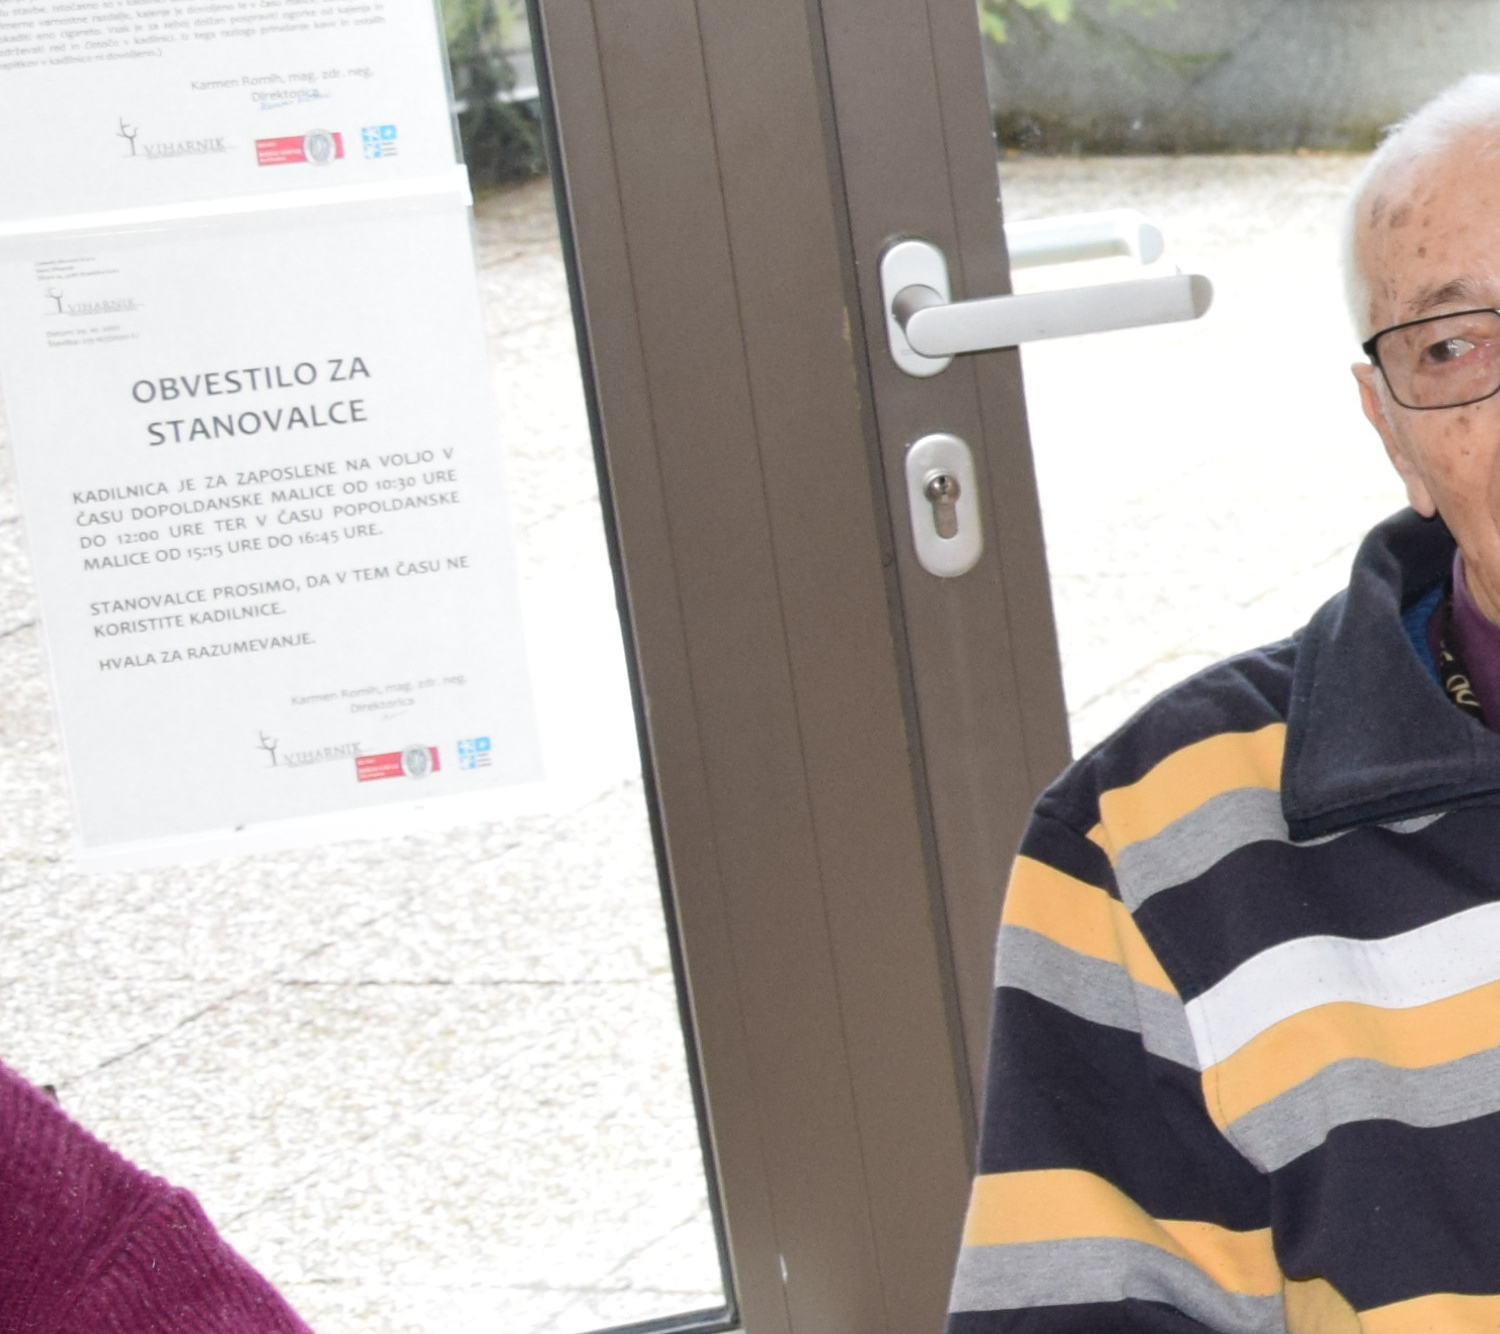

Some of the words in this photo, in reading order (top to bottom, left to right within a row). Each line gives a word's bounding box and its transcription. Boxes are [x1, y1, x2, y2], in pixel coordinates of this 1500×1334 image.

[191, 78, 239, 91] Karmen
[242, 73, 285, 87] Romih,
[251, 88, 319, 103] Direktorica
[144, 137, 226, 157] VIHARNIK
[131, 361, 318, 404] OBVESTILO
[327, 356, 371, 383] ZA
[146, 398, 368, 447] STANOVALCE
[72, 482, 169, 505] KADILNICA
[179, 478, 195, 494] JE
[205, 474, 228, 489] ZA
[236, 461, 337, 486] ZAPOSLENE
[345, 457, 371, 472] NA
[379, 450, 434, 467] VOLJO
[442, 448, 453, 461] V
[75, 508, 123, 527] ČASU
[130, 492, 262, 521] DOPOLDANSKE
[271, 484, 334, 503] MALICE
[342, 480, 368, 495] OD
[375, 476, 416, 491] 10:30
[423, 469, 456, 485] URE
[79, 534, 107, 550] DO
[117, 530, 159, 544] 12:00
[169, 522, 204, 539] URE
[214, 517, 247, 532] TER
[255, 515, 267, 527] V
[277, 508, 323, 525] ČASU
[333, 491, 459, 517] POPOLDANSKE
[83, 551, 150, 571] MALICE
[155, 548, 182, 563] OD
[227, 537, 262, 554] URE
[267, 534, 293, 549] DO
[298, 529, 339, 545] 16:45
[343, 523, 383, 540] URE.
[90, 589, 206, 616] STANOVALCE
[212, 578, 301, 600] PROSIMO,
[306, 574, 331, 588] DA
[335, 571, 346, 584] V
[352, 566, 390, 581] TEM
[395, 559, 440, 577] ČASU
[446, 555, 469, 570] NE
[93, 614, 185, 638] KORISTITE
[189, 602, 286, 625] KADILNICE.
[99, 653, 157, 671] HVALA
[160, 649, 183, 664] ZA
[186, 632, 316, 660] RAZUMEVANJE.
[291, 691, 338, 707] Karmen
[350, 697, 416, 713] Direktorica
[284, 742, 361, 764] VIHARNIK
